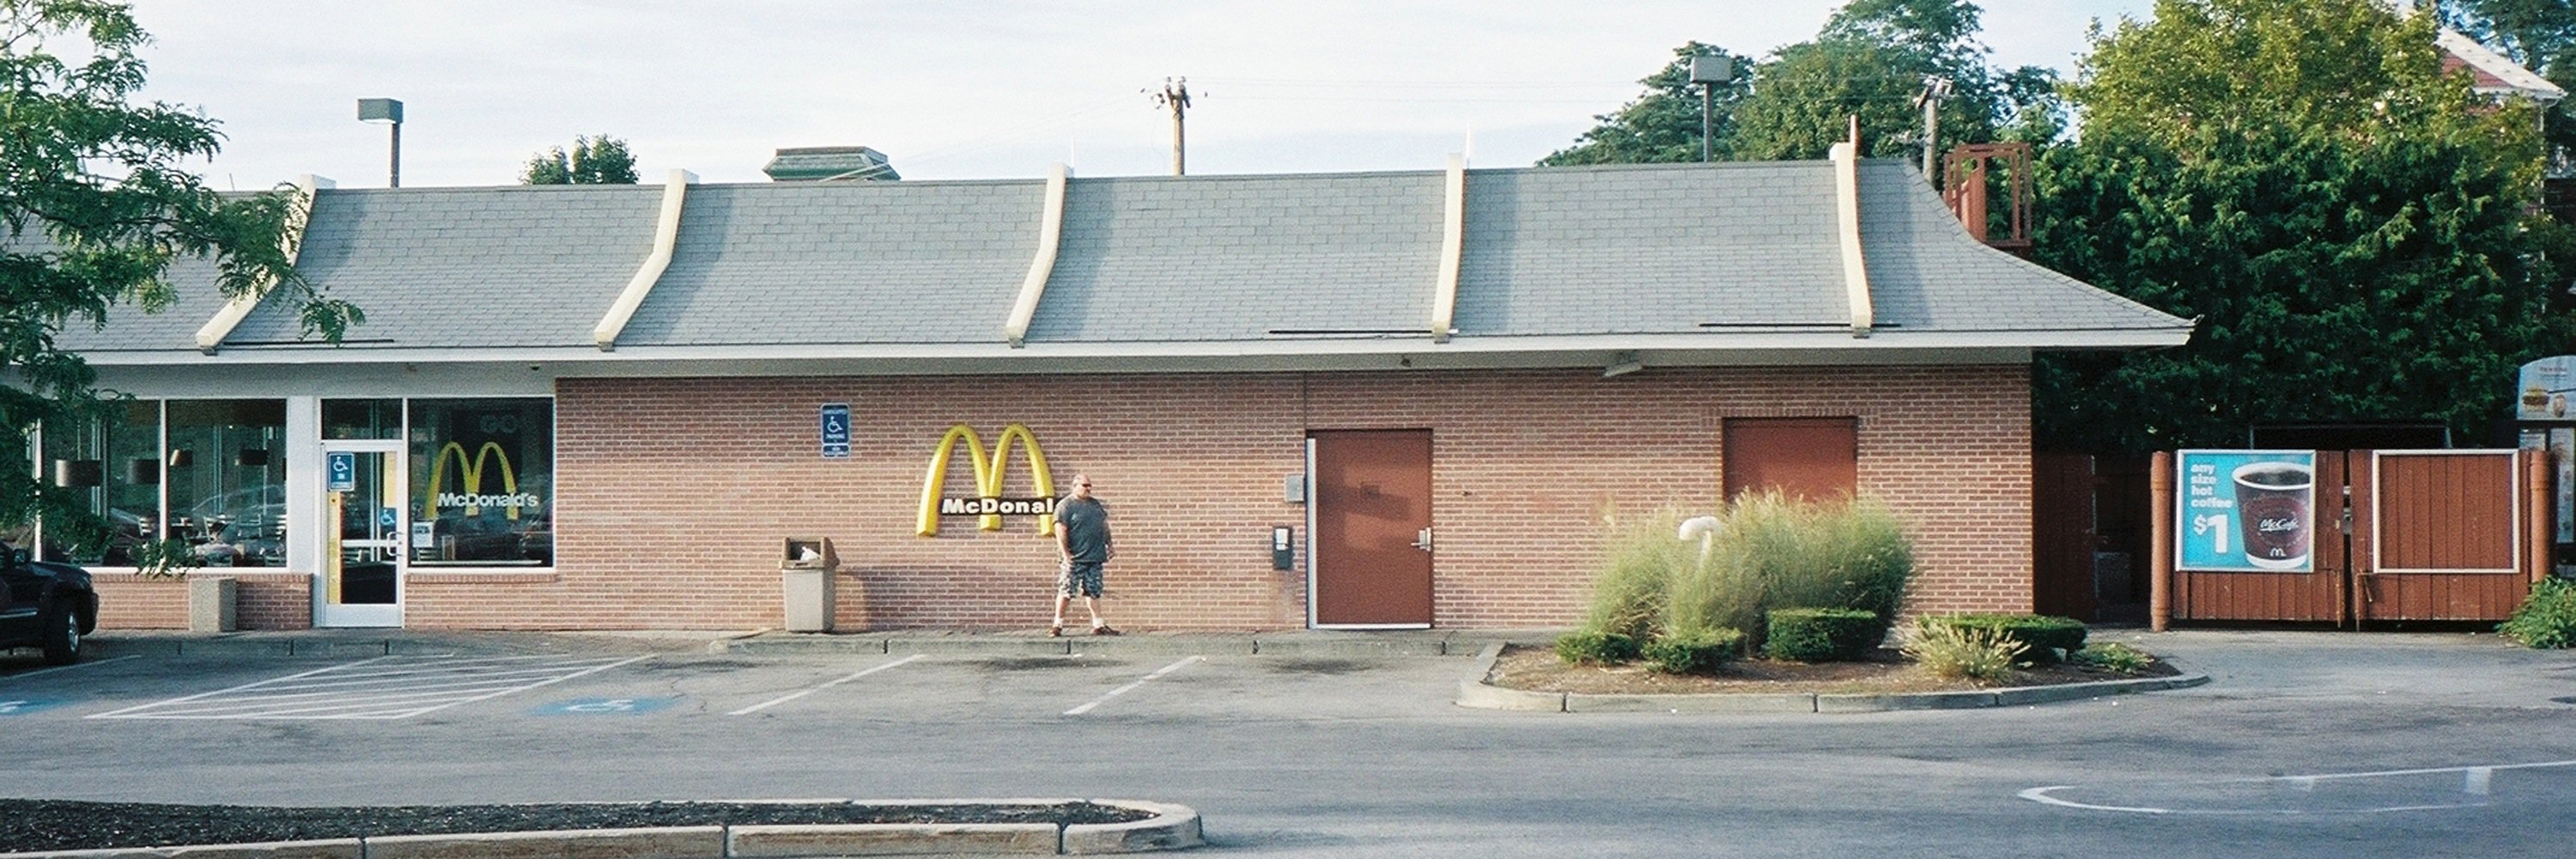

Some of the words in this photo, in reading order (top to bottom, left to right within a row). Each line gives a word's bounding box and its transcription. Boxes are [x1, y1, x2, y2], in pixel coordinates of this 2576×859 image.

[2190, 464, 2215, 475] any
[2190, 474, 2216, 484] size
[2190, 485, 2213, 496] hot
[437, 492, 538, 507] McDonald's
[2190, 497, 2233, 509] coffee
[942, 498, 1054, 514] McDonal
[2193, 515, 2227, 554] $1
